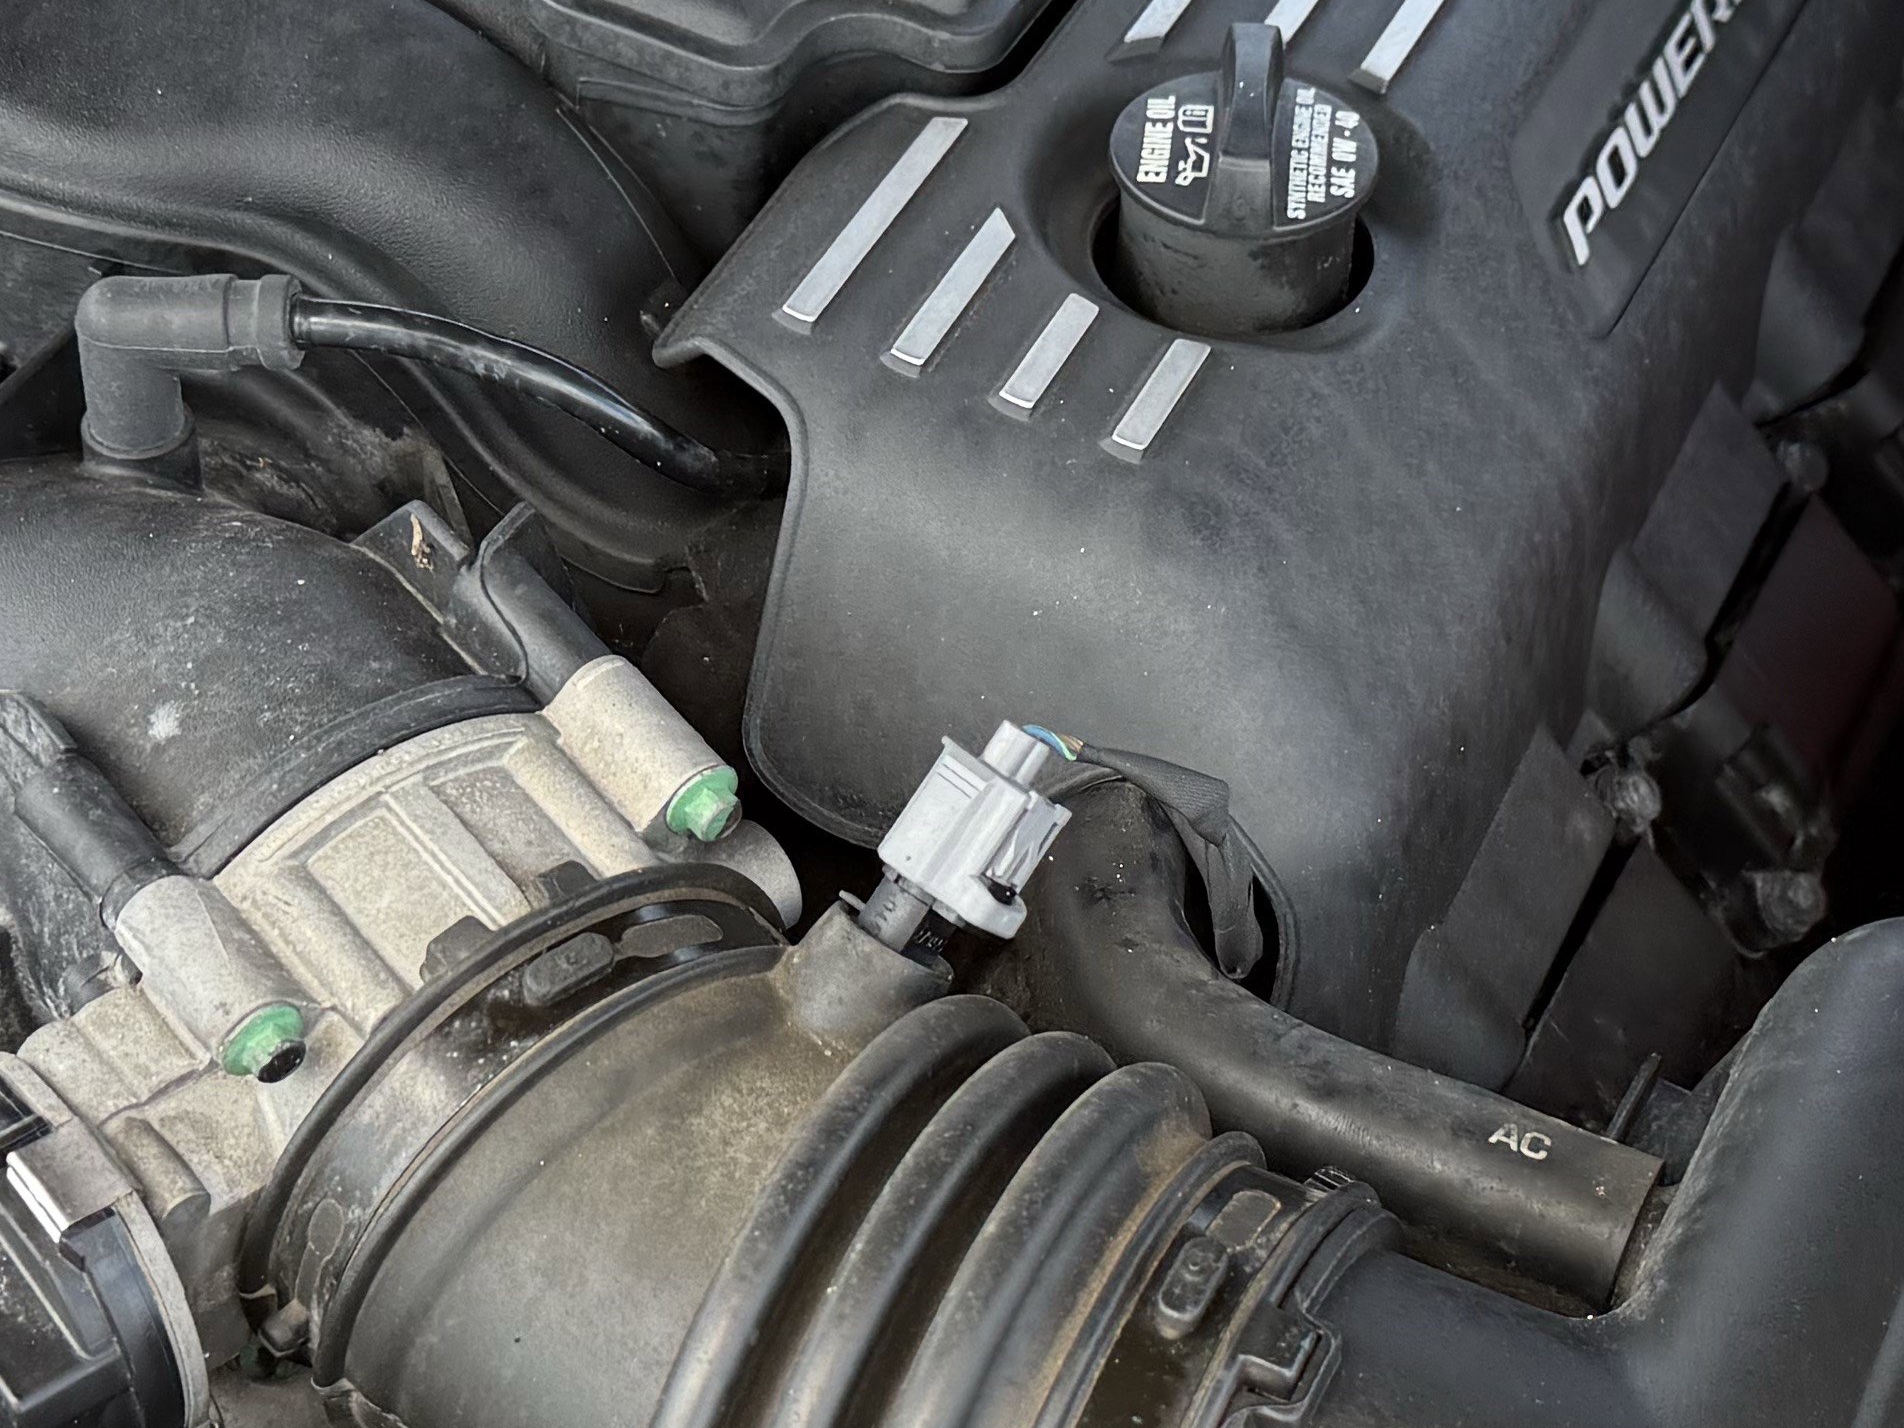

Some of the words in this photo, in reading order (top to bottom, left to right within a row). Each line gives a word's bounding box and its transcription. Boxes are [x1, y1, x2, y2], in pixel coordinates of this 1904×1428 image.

[1145, 94, 1177, 119] OIL
[1296, 86, 1316, 104] OIL
[1291, 104, 1313, 148] ENGINE
[1136, 121, 1174, 183] ENGINE
[1307, 104, 1332, 203] RECOMMENDED
[1286, 149, 1309, 220] SYNTHETIC
[1329, 165, 1356, 199] SAE
[1487, 1122, 1553, 1161] AC
